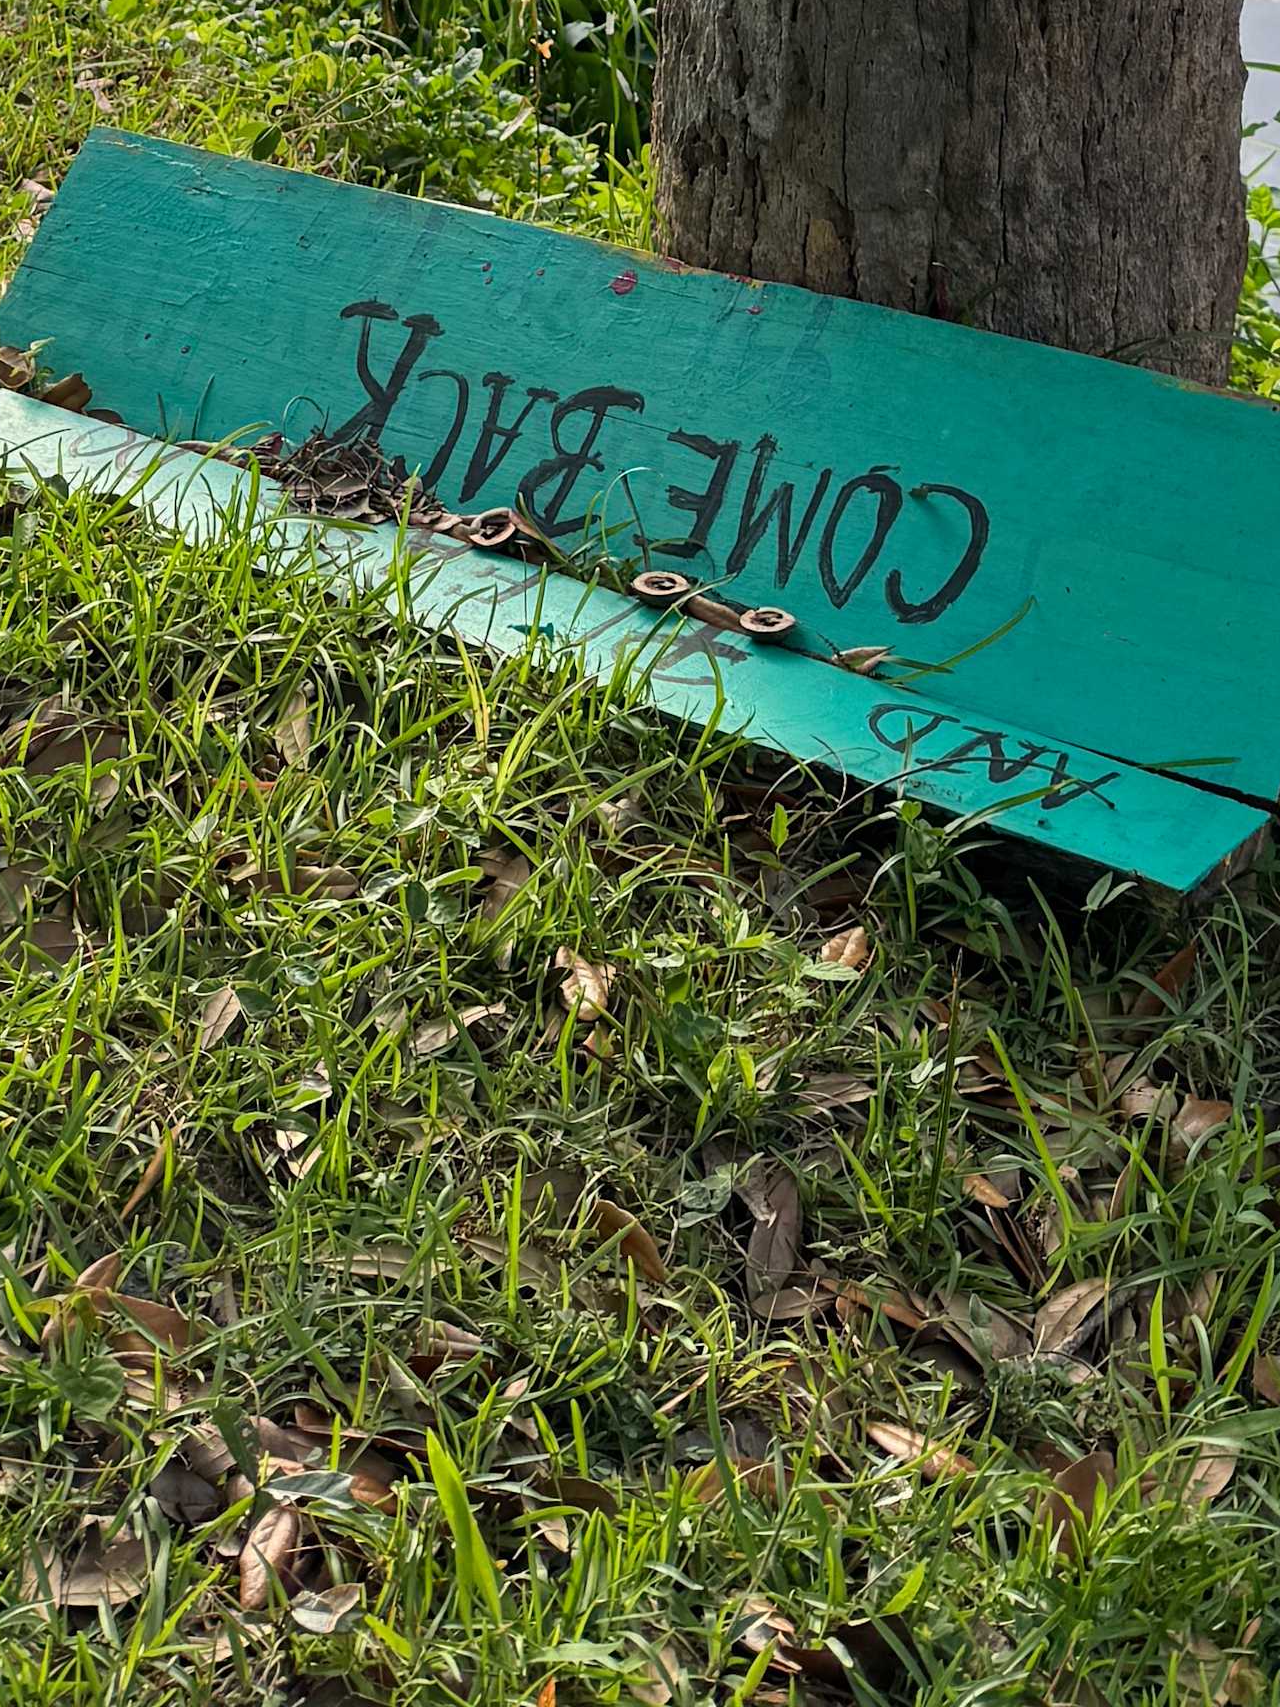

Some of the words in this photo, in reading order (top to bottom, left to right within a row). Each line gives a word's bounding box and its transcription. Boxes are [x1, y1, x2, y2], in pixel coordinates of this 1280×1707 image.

[332, 297, 646, 538] BACK
[632, 426, 990, 624] COME
[867, 702, 1120, 811] AND
